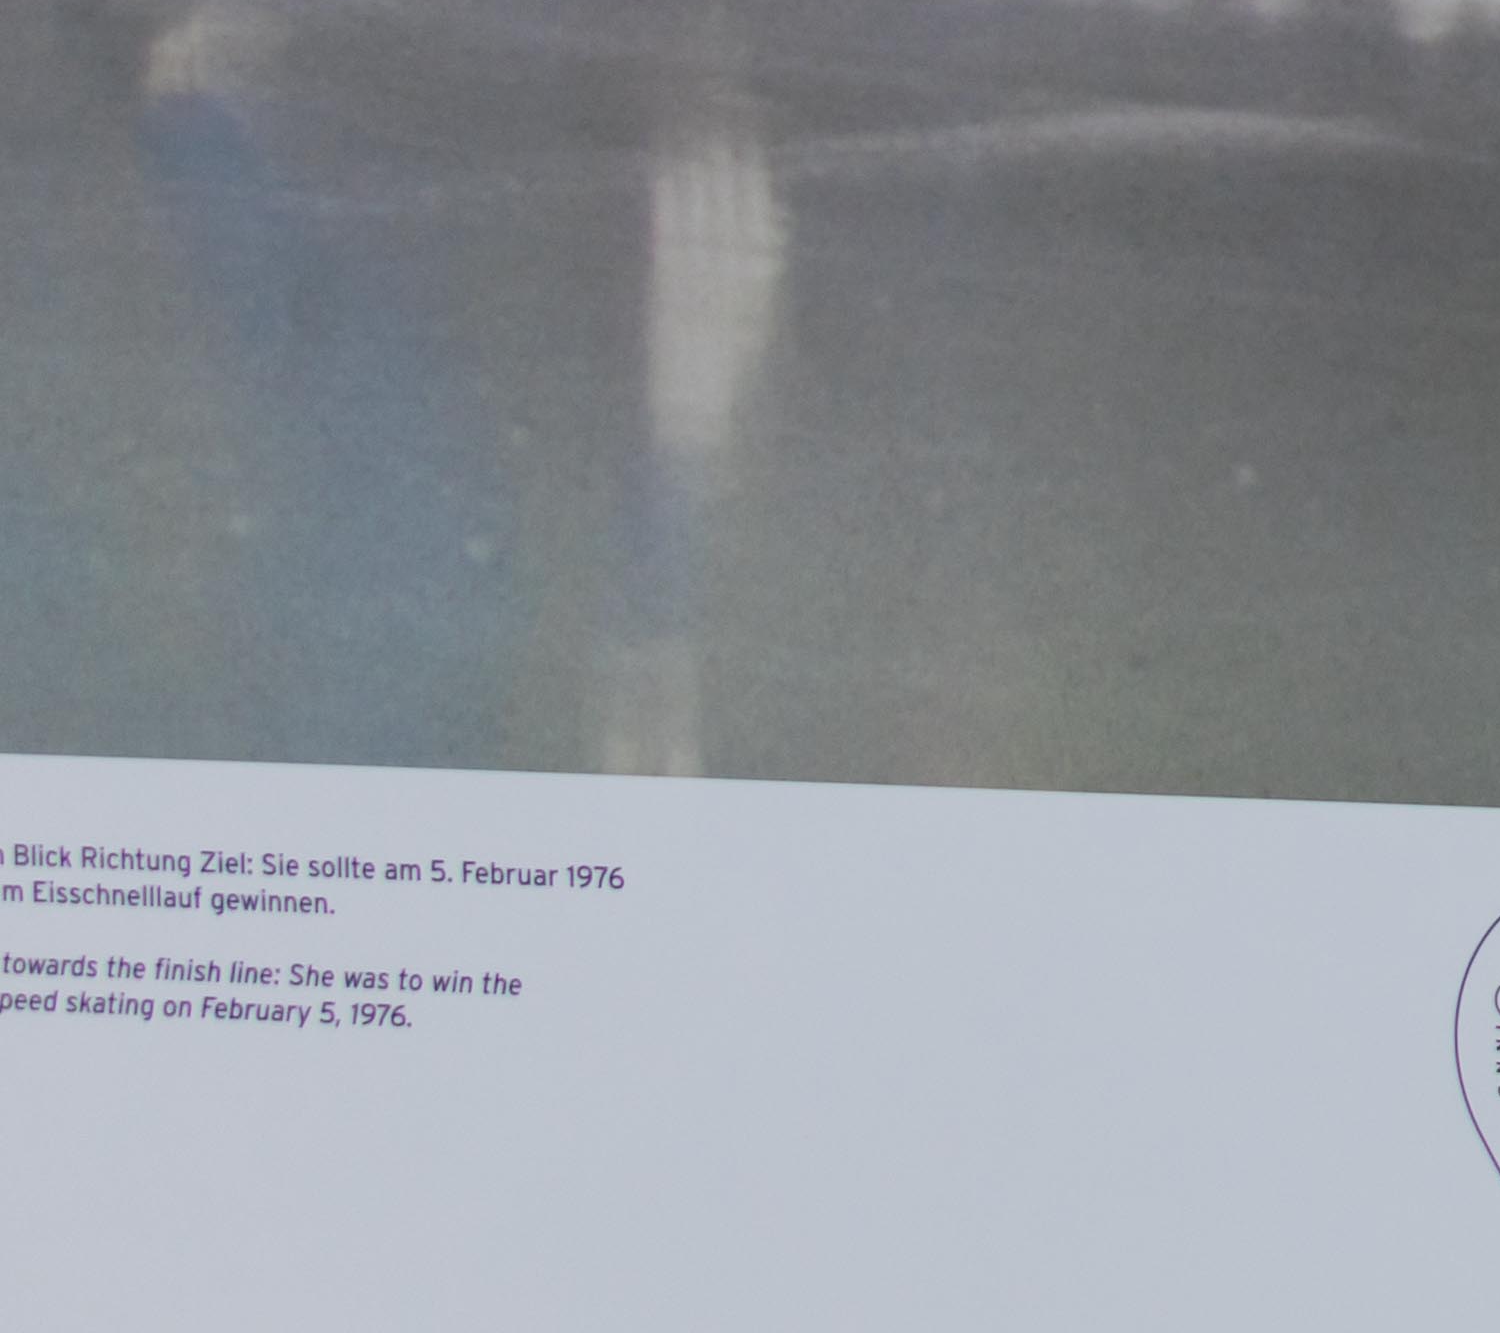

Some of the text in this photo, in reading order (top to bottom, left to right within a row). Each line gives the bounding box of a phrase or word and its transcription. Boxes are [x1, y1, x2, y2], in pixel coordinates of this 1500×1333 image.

[13, 843, 72, 869] Blick
[81, 845, 192, 878] Richtung
[200, 850, 253, 875] Ziel:
[262, 852, 300, 877] Sie
[308, 856, 376, 880] sollte
[384, 862, 421, 881] am
[430, 859, 454, 884] 5.
[462, 861, 558, 887] Februar
[566, 864, 625, 890] 1976
[33, 880, 202, 910] Eisschnelllauf
[210, 888, 336, 916] gewinnen.
[2, 951, 523, 996] towards the finish line: She was to win the
[65, 991, 155, 1021] skating
[163, 998, 193, 1019] on
[201, 995, 312, 1028] February
[319, 1001, 342, 1028] 5,
[351, 1002, 413, 1028] 1976.
